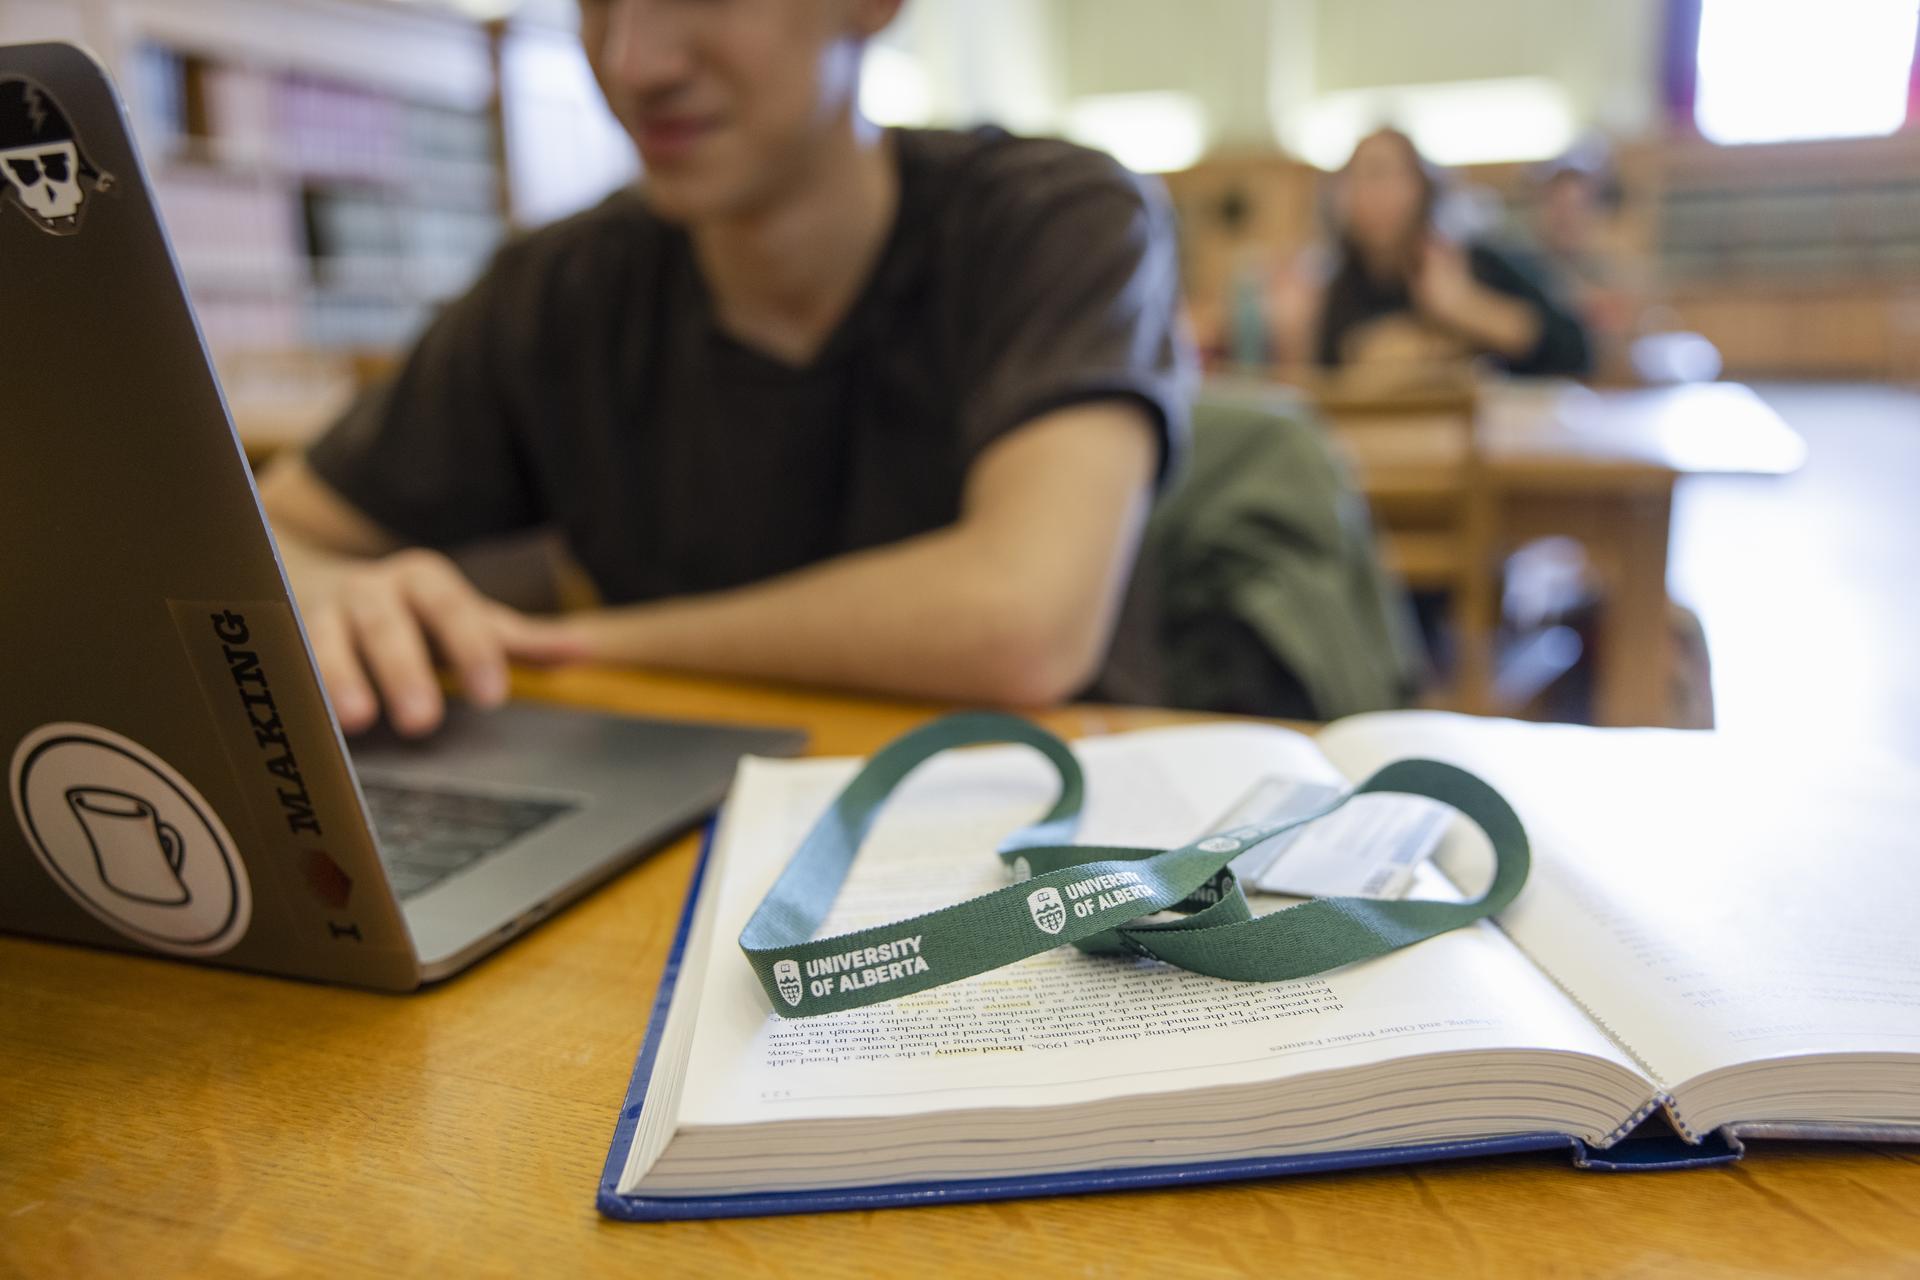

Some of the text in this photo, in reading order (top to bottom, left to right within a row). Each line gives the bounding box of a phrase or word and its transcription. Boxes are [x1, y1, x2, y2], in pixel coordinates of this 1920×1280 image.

[211, 609, 322, 836] MAKING
[1064, 872, 1142, 900] UNIVERSITY
[1073, 898, 1095, 918] OF
[1098, 884, 1157, 911] ALBERTA
[806, 935, 922, 978] UNIVERSITY
[810, 956, 930, 998] OF ALBERTA
[1035, 991, 1056, 999] will
[1072, 993, 1111, 1002] equity
[1117, 988, 1154, 998] brand
[1129, 989, 1211, 1004] connotations
[1232, 990, 1264, 999] what
[937, 1005, 975, 1013] aspect
[983, 1001, 1031, 1010] positive
[1044, 1001, 1110, 1014] favourable
[1151, 998, 1207, 1011] supposed
[1202, 1000, 1251, 1013] Reebok
[1322, 1003, 1343, 1012] the
[847, 1010, 894, 1018] product
[980, 1008, 1041, 1018] attributes
[1058, 1011, 1095, 1022] brand
[1118, 1010, 1168, 1022] product
[1272, 1007, 1320, 1019] hottest
[878, 1016, 922, 1025] quality
[987, 1018, 1021, 1026] value
[1025, 1016, 1054, 1024] adds
[1087, 1018, 1115, 1027] adds
[1160, 1017, 1199, 1027] minds
[1231, 1015, 1270, 1025] topics
[883, 1023, 934, 1033] product
[940, 1022, 965, 1030] that
[1049, 1021, 1083, 1030] value
[1105, 1023, 1140, 1032] many
[1144, 1024, 1210, 1035] marketing
[1379, 1024, 1415, 1035] Other
[829, 1027, 880, 1037] through
[890, 1030, 948, 1041] product's
[963, 1028, 1011, 1037] Beyond
[1098, 1032, 1141, 1042] during
[1326, 1031, 1375, 1043] Product
[851, 1036, 886, 1044] value
[952, 1037, 998, 1045] having
[900, 1041, 938, 1050] brand
[982, 1044, 1024, 1054] Brand
[1269, 1039, 1323, 1052] Features
[935, 1047, 977, 1056] equity
[800, 1056, 839, 1065] brand
[855, 1053, 890, 1061] value
[766, 1058, 796, 1067] adds
